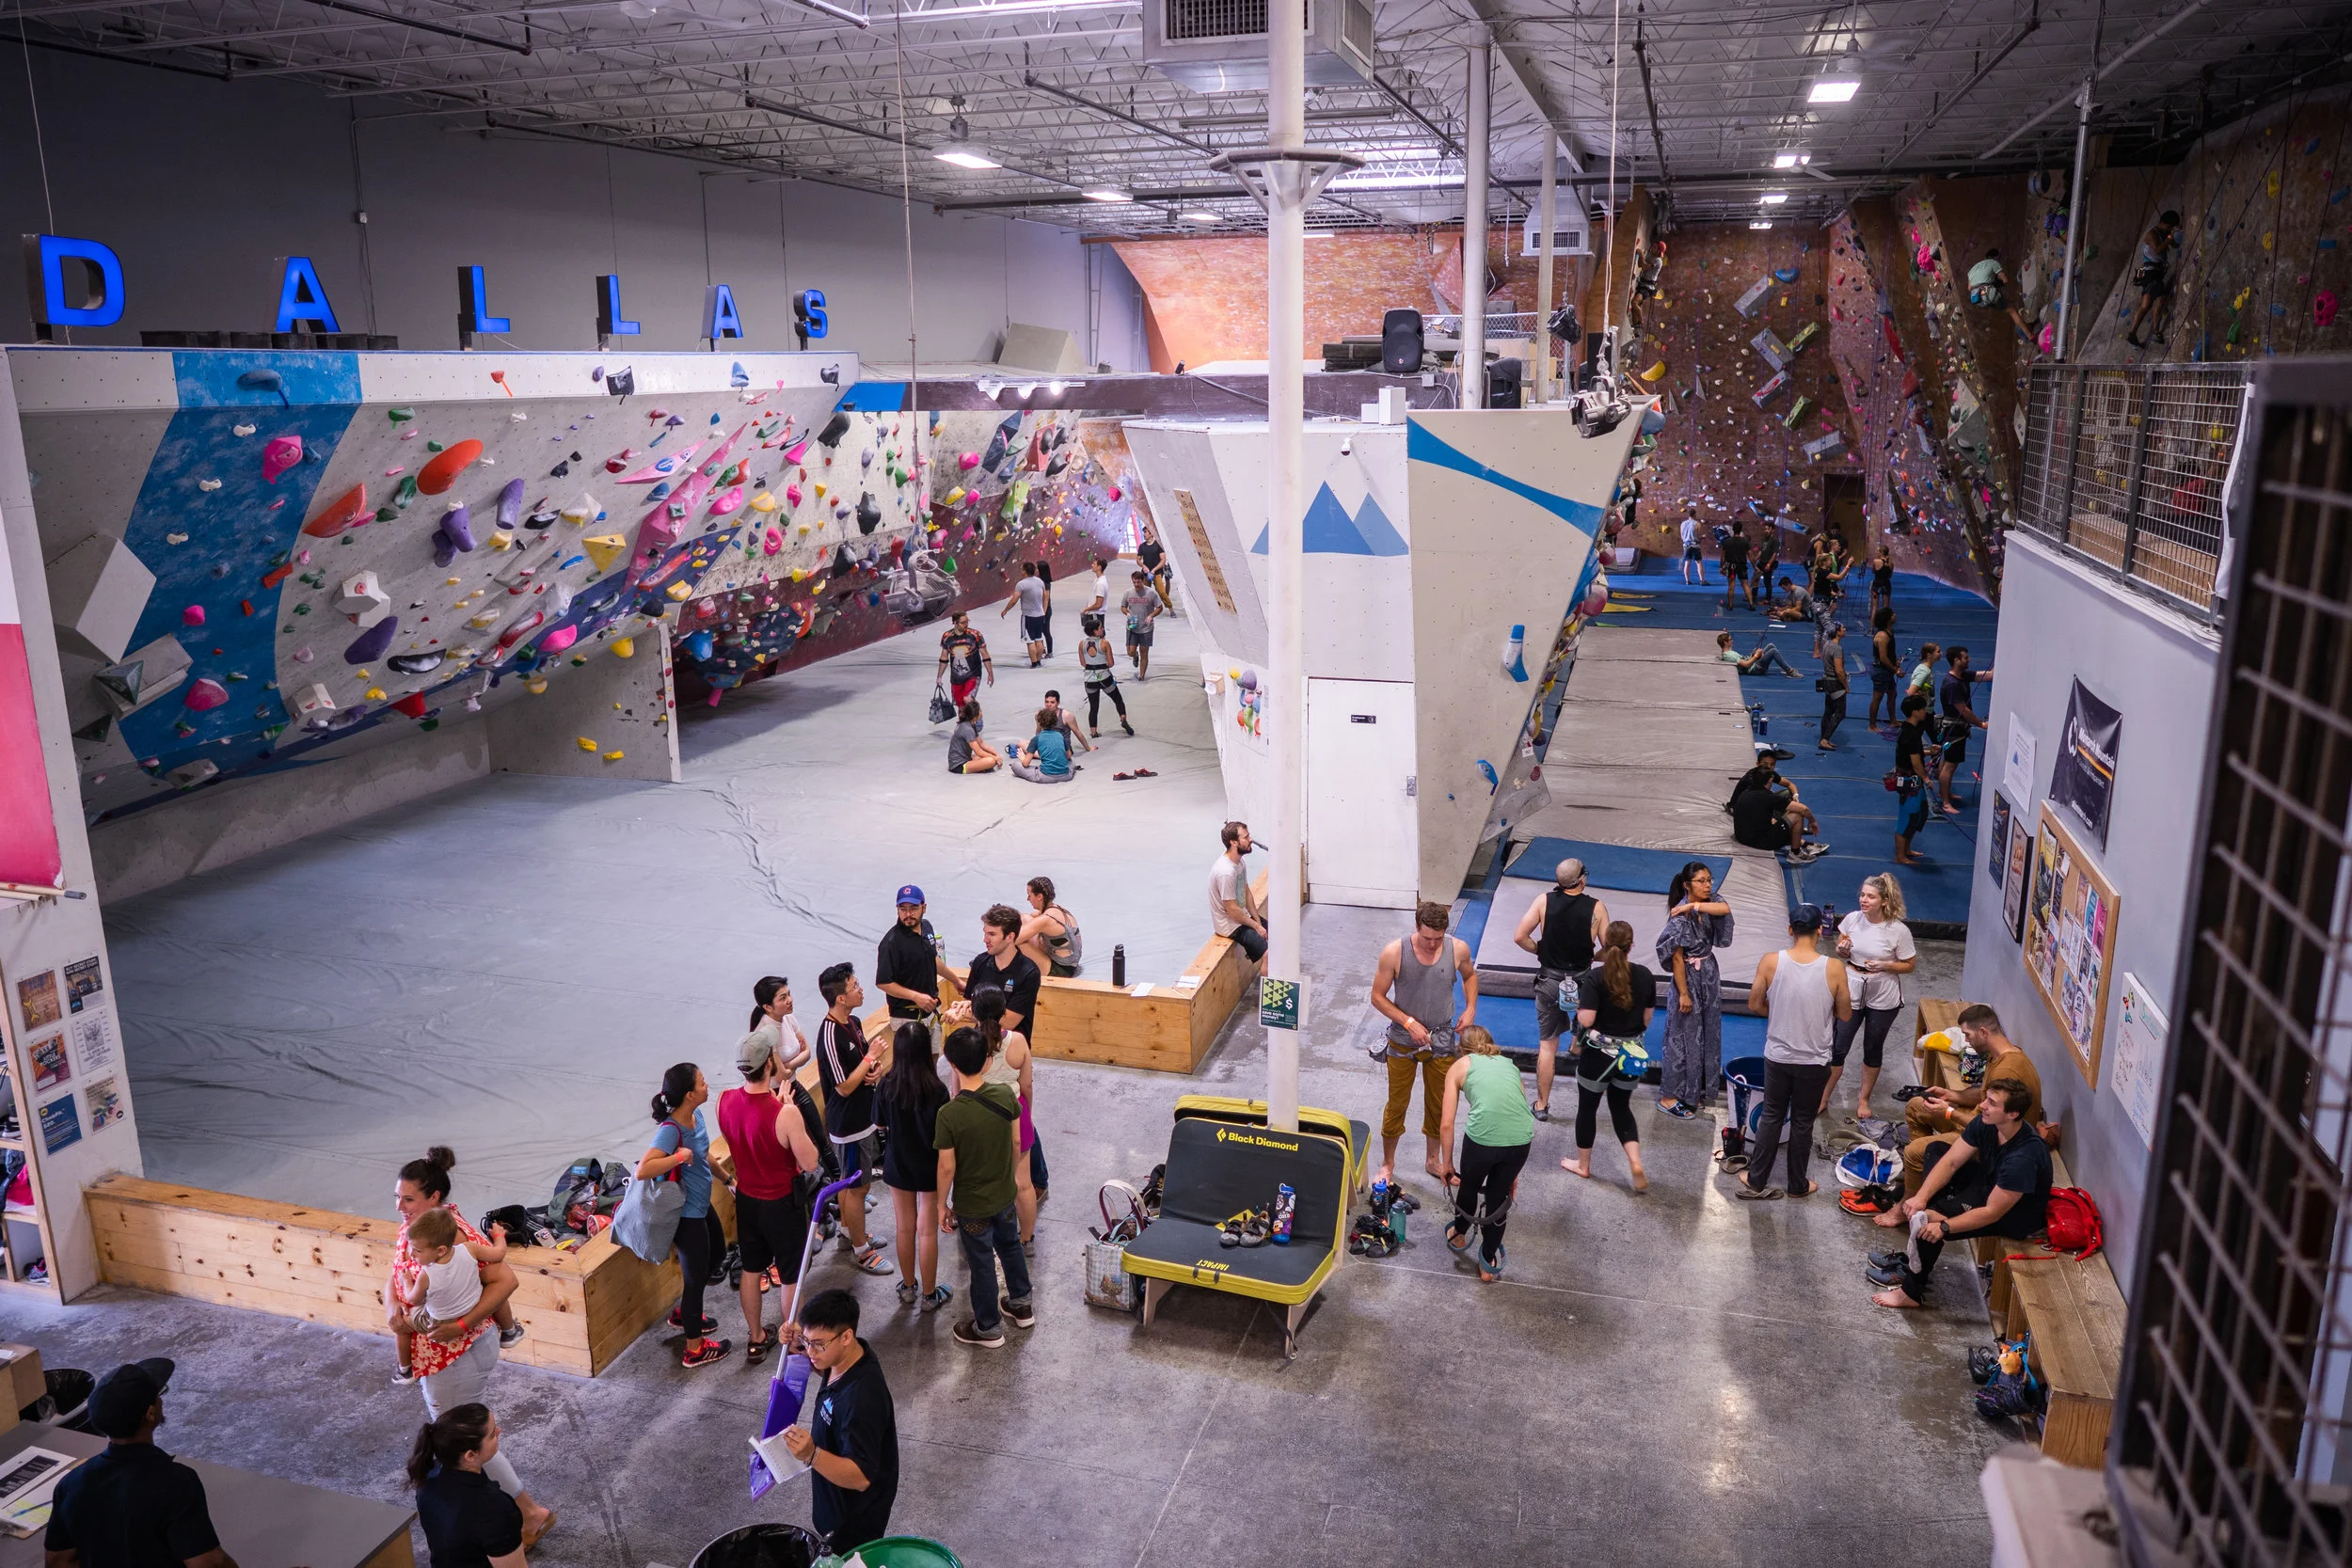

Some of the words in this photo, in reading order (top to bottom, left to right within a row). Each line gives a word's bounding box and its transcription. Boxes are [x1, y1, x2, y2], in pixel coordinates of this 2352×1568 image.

[2078, 727, 2096, 752] Monarch
[2094, 741, 2115, 771] Mountain
[1228, 1132, 1254, 1145] Black
[1255, 1136, 1299, 1152] Diamond
[1195, 1259, 1231, 1272] IMPACT
